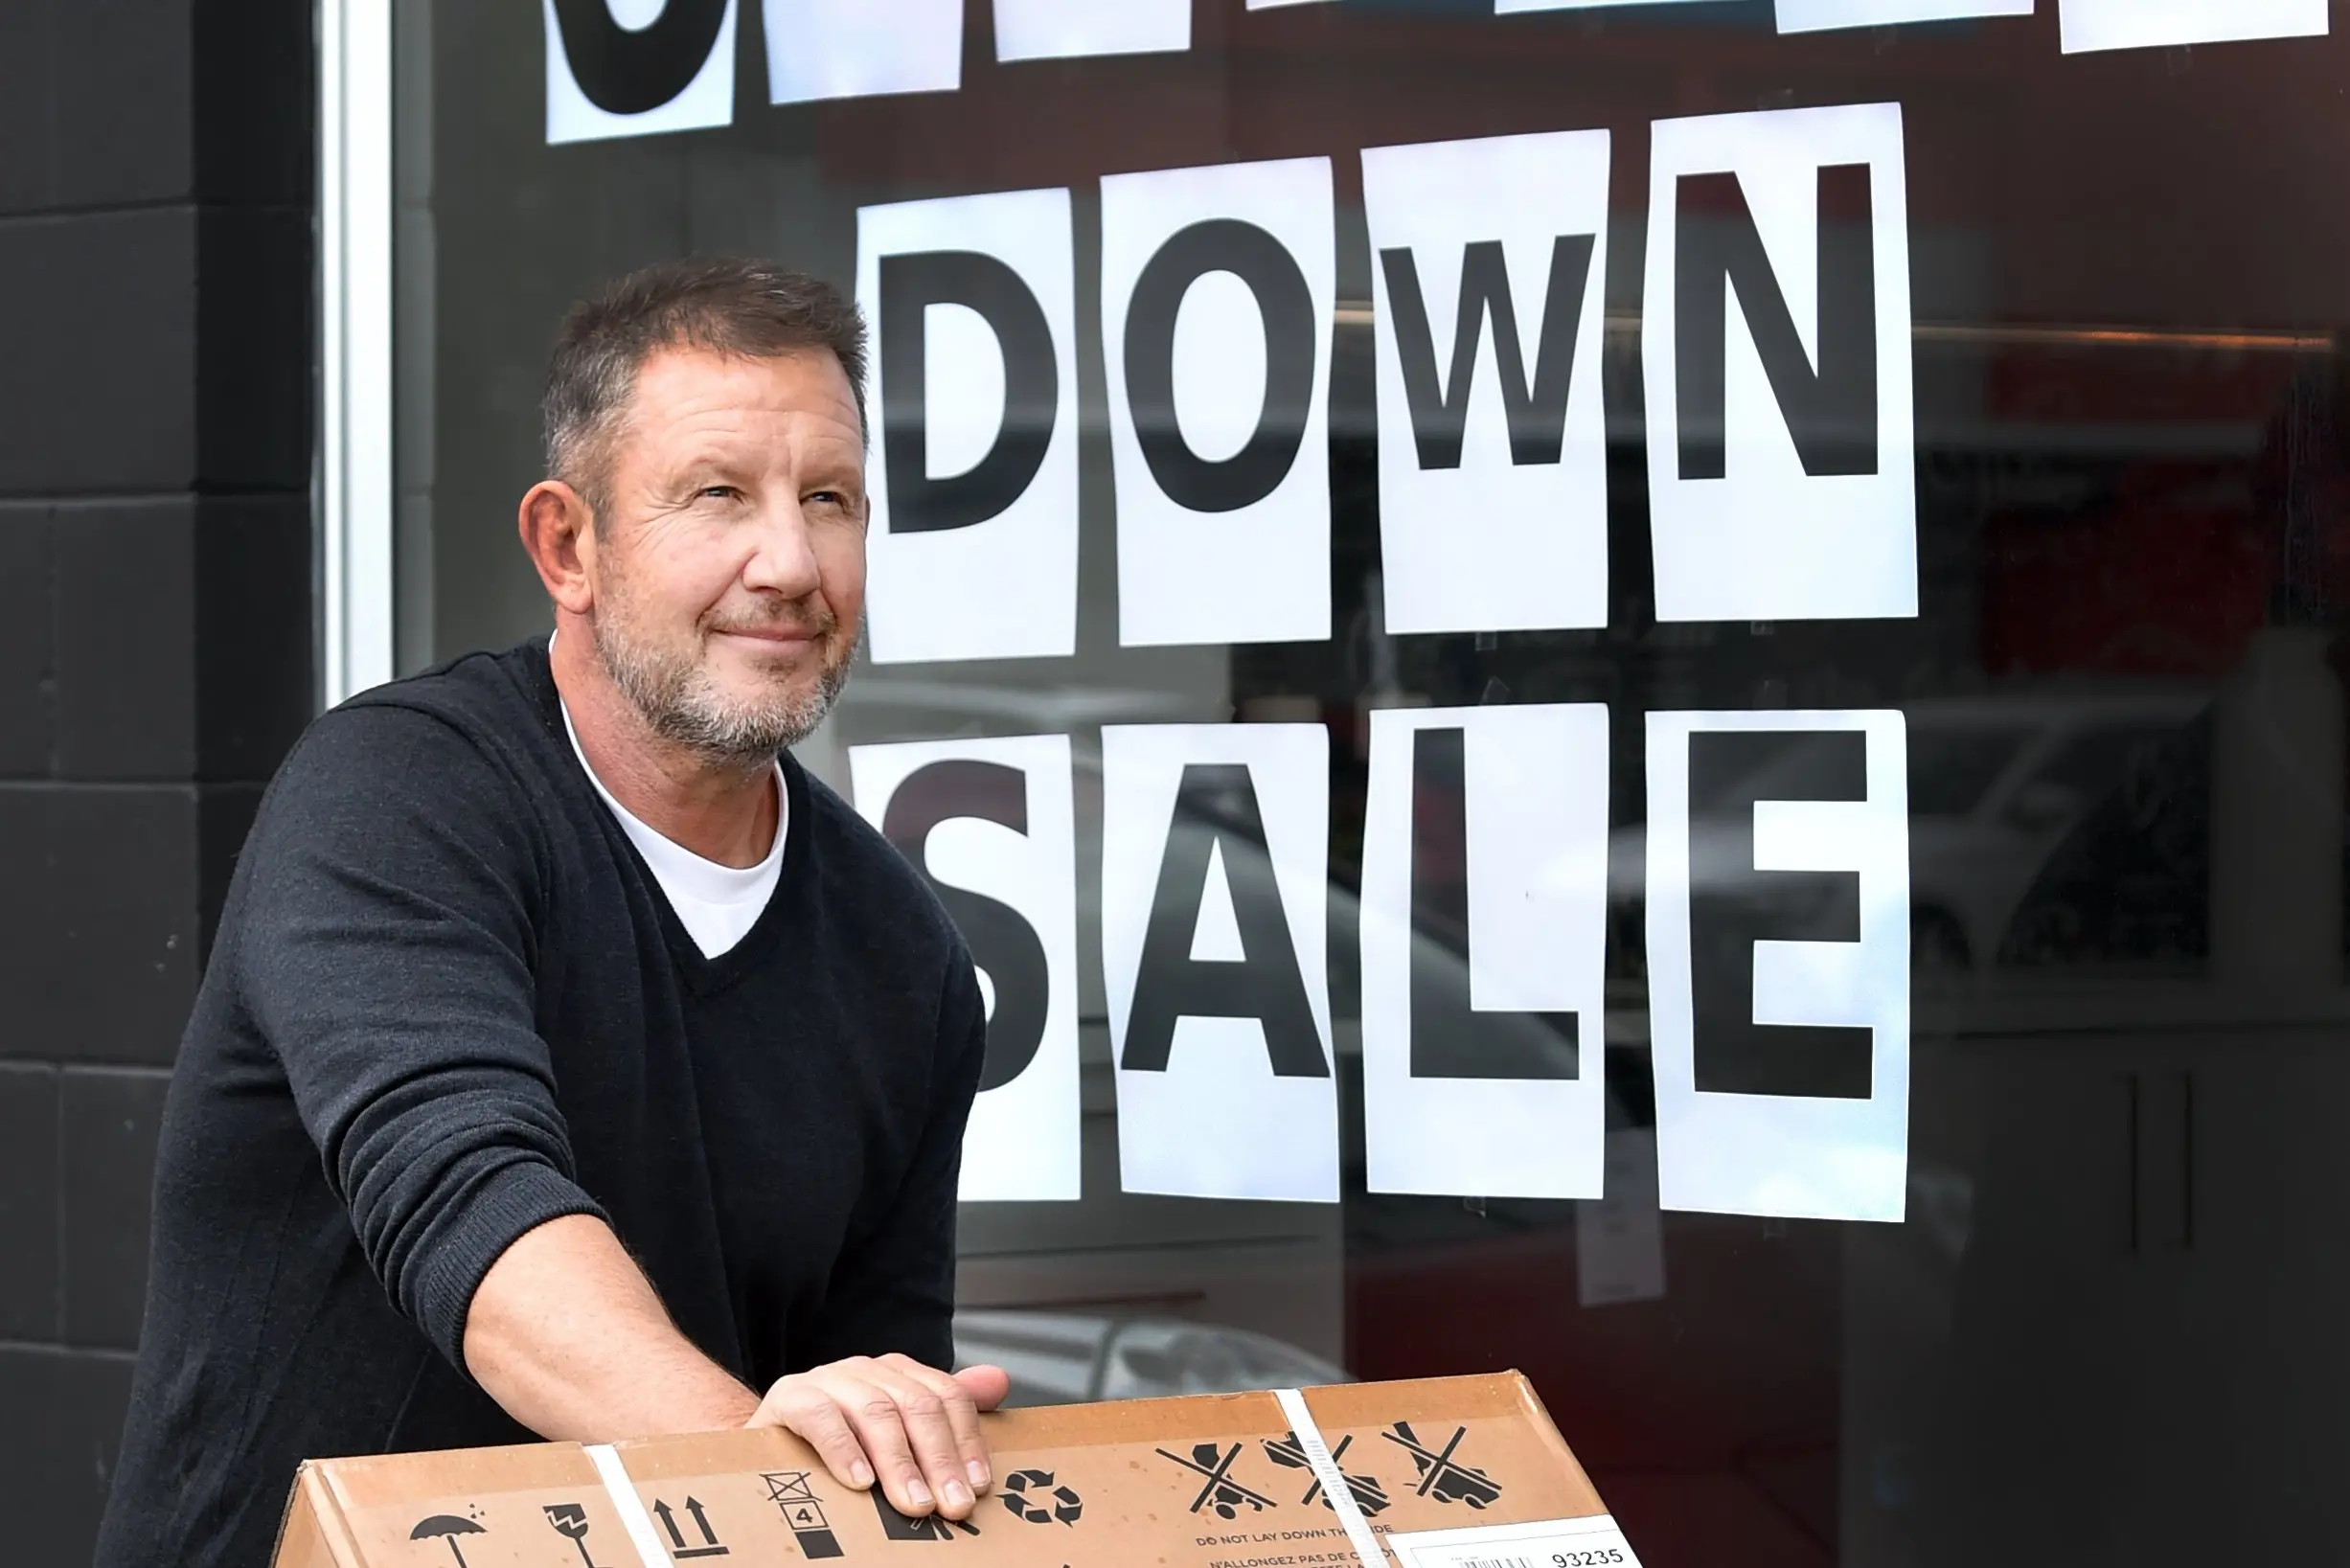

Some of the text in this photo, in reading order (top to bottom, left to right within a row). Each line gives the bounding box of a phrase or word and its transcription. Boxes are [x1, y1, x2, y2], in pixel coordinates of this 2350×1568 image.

[878, 162, 1879, 534] DOWN
[883, 726, 1875, 1100] SALE
[796, 1508, 813, 1523] 4
[1196, 1536, 1218, 1546] DO
[1220, 1534, 1248, 1544] NOT
[1252, 1532, 1277, 1542] LAY
[1281, 1530, 1326, 1540] DOWN
[1369, 1524, 1393, 1534] IDE
[1298, 1554, 1325, 1563] PAS
[1328, 1552, 1347, 1562] DE
[1552, 1549, 1624, 1568] 93235
